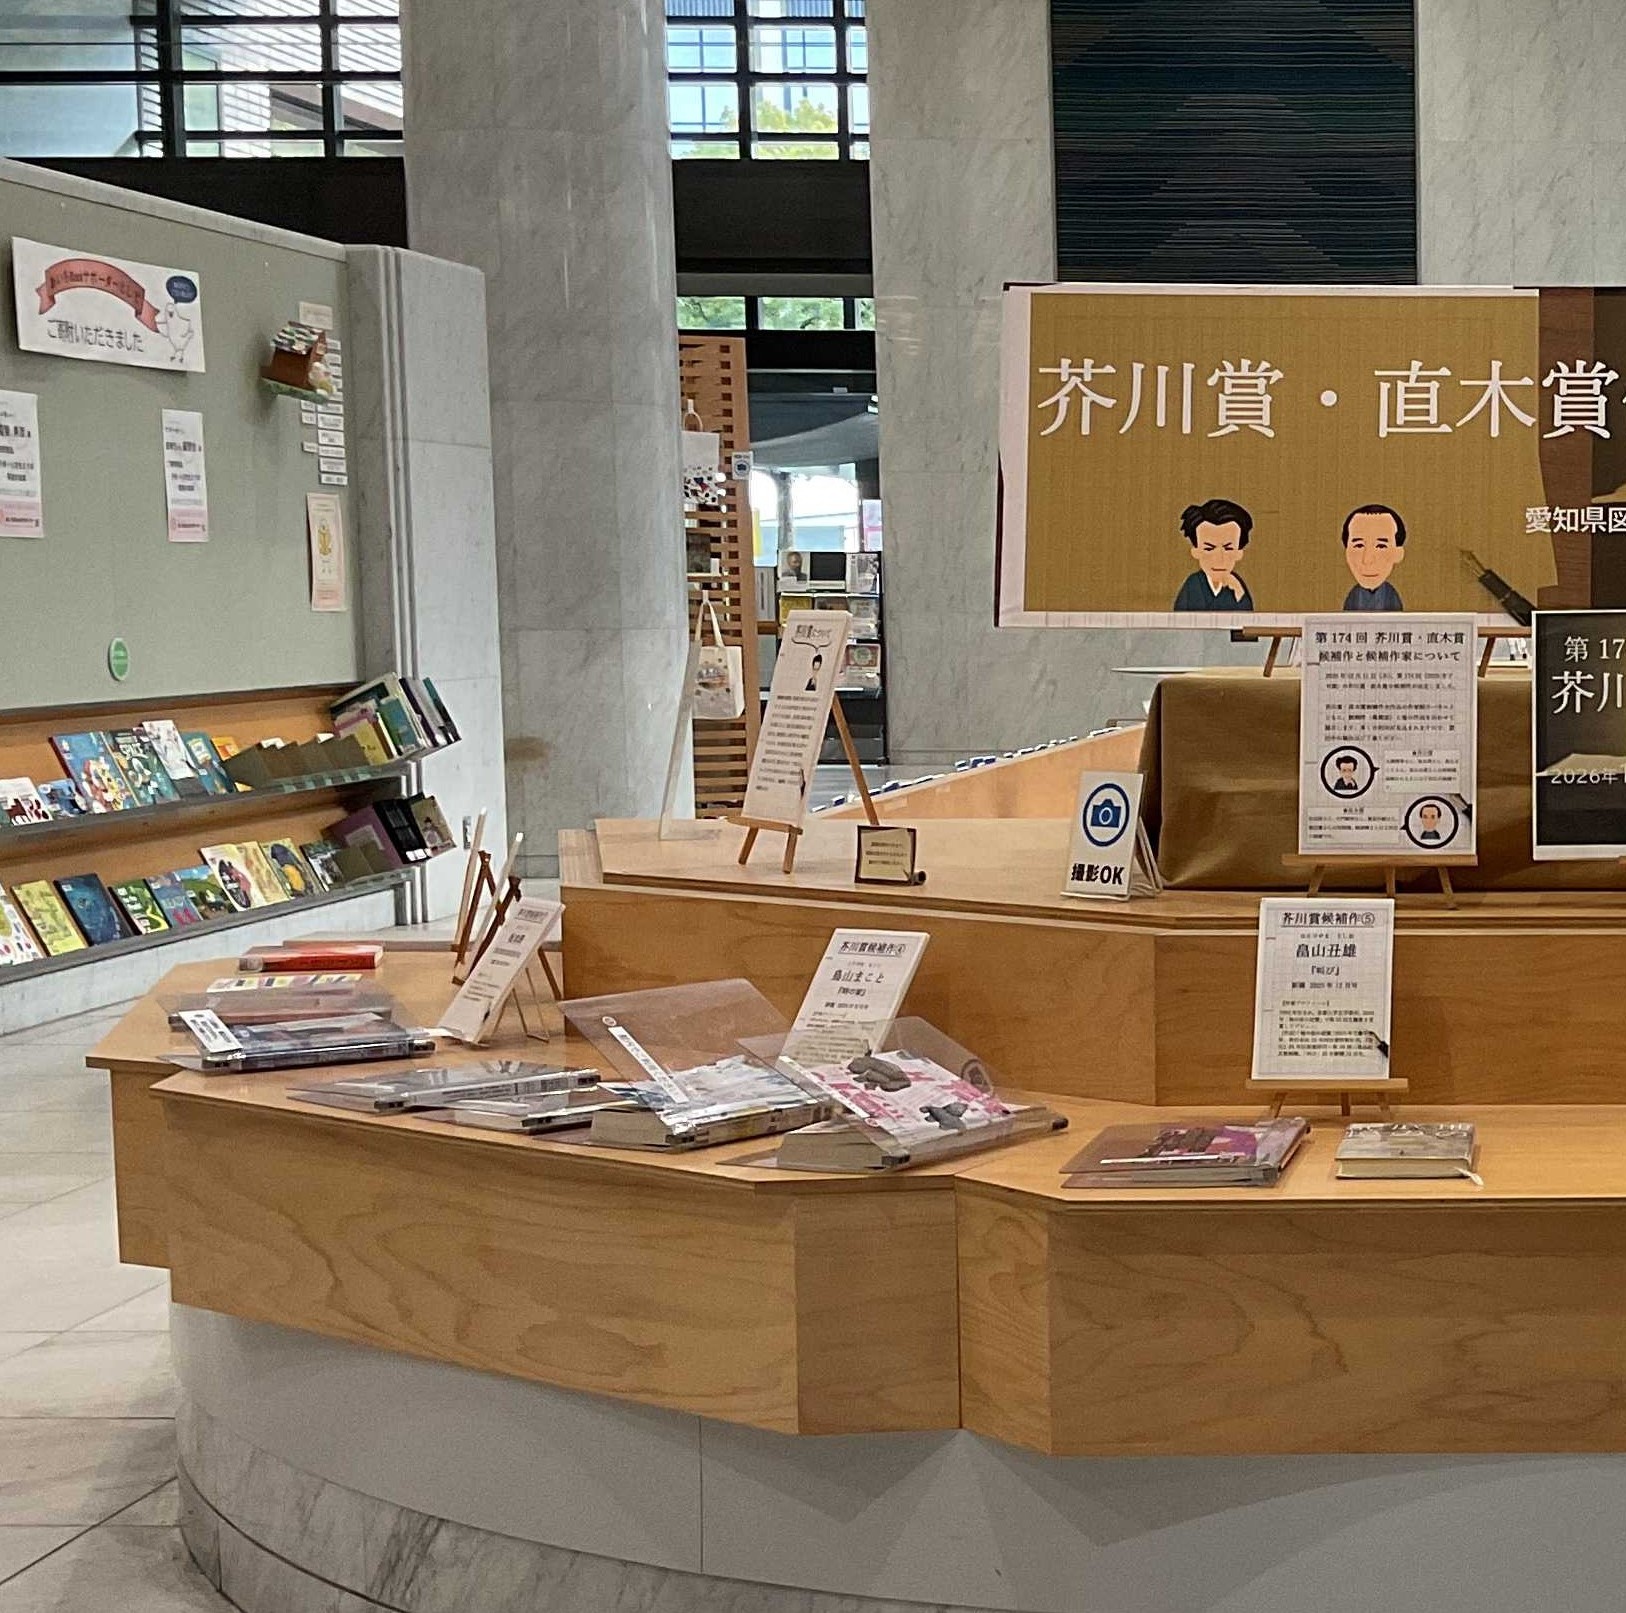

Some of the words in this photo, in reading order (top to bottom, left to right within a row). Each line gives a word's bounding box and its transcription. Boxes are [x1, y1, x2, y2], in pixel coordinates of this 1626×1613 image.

[1319, 651, 1461, 663] 候補作と候補作家について
[1071, 863, 1125, 885] 撮影OK
[1296, 943, 1357, 958] 畠山丑雄
